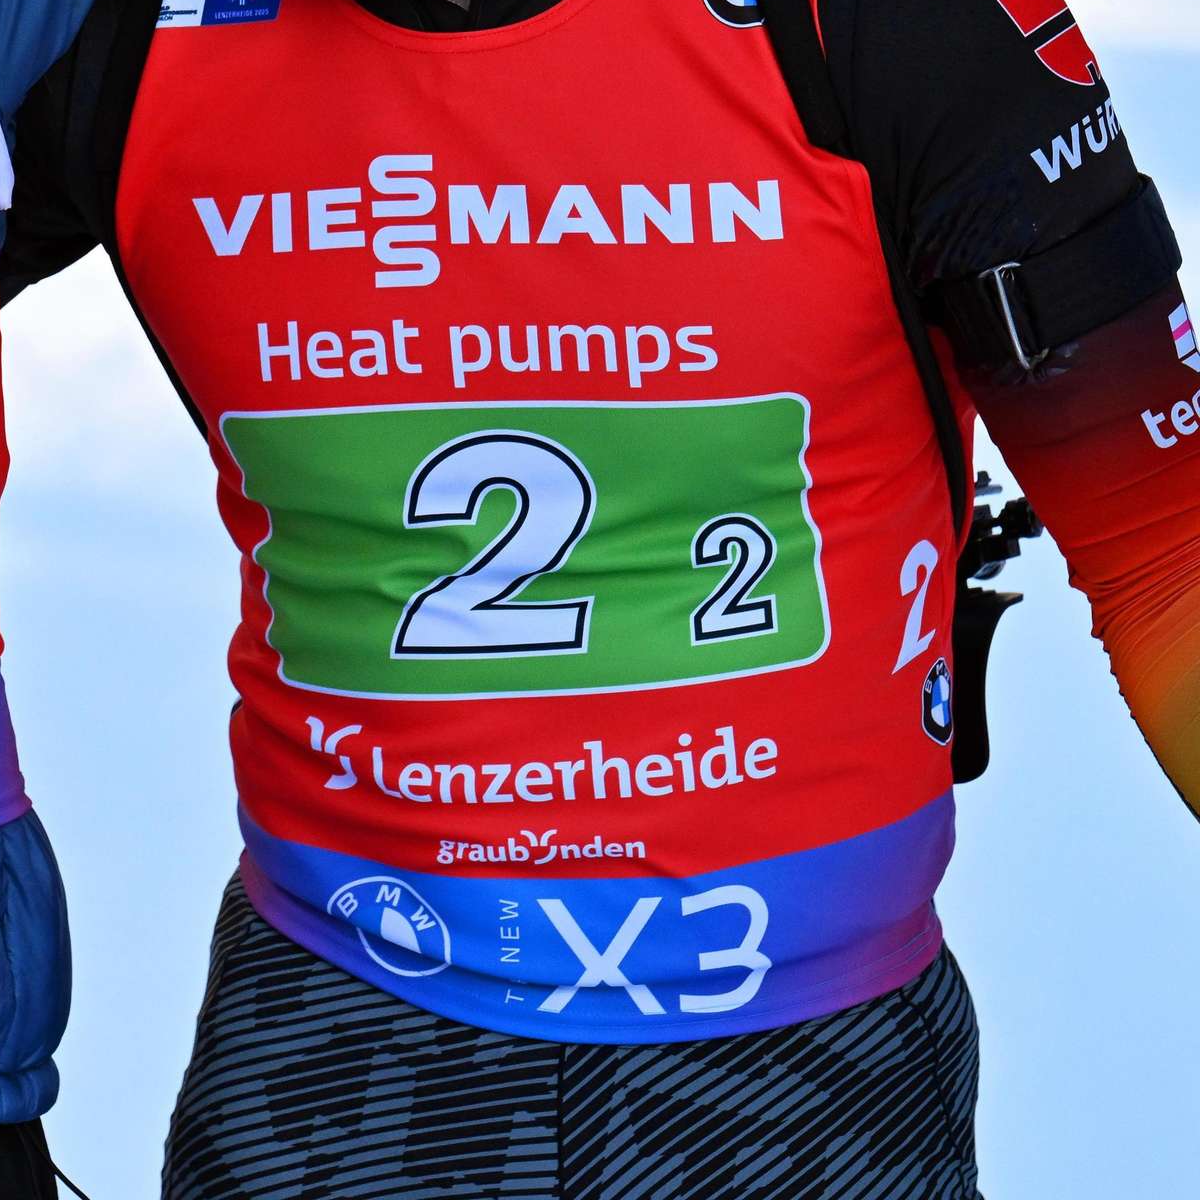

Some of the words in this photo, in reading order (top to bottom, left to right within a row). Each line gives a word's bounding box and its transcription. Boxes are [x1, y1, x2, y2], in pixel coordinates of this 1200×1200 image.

[192, 154, 785, 289] VIESSMANN
[257, 319, 423, 382] Heat
[448, 324, 719, 389] pumps
[390, 429, 598, 661] 2
[690, 513, 778, 647] 2
[891, 539, 939, 675] 2
[372, 725, 779, 805] Lenzerheide
[537, 884, 773, 1016] X3
